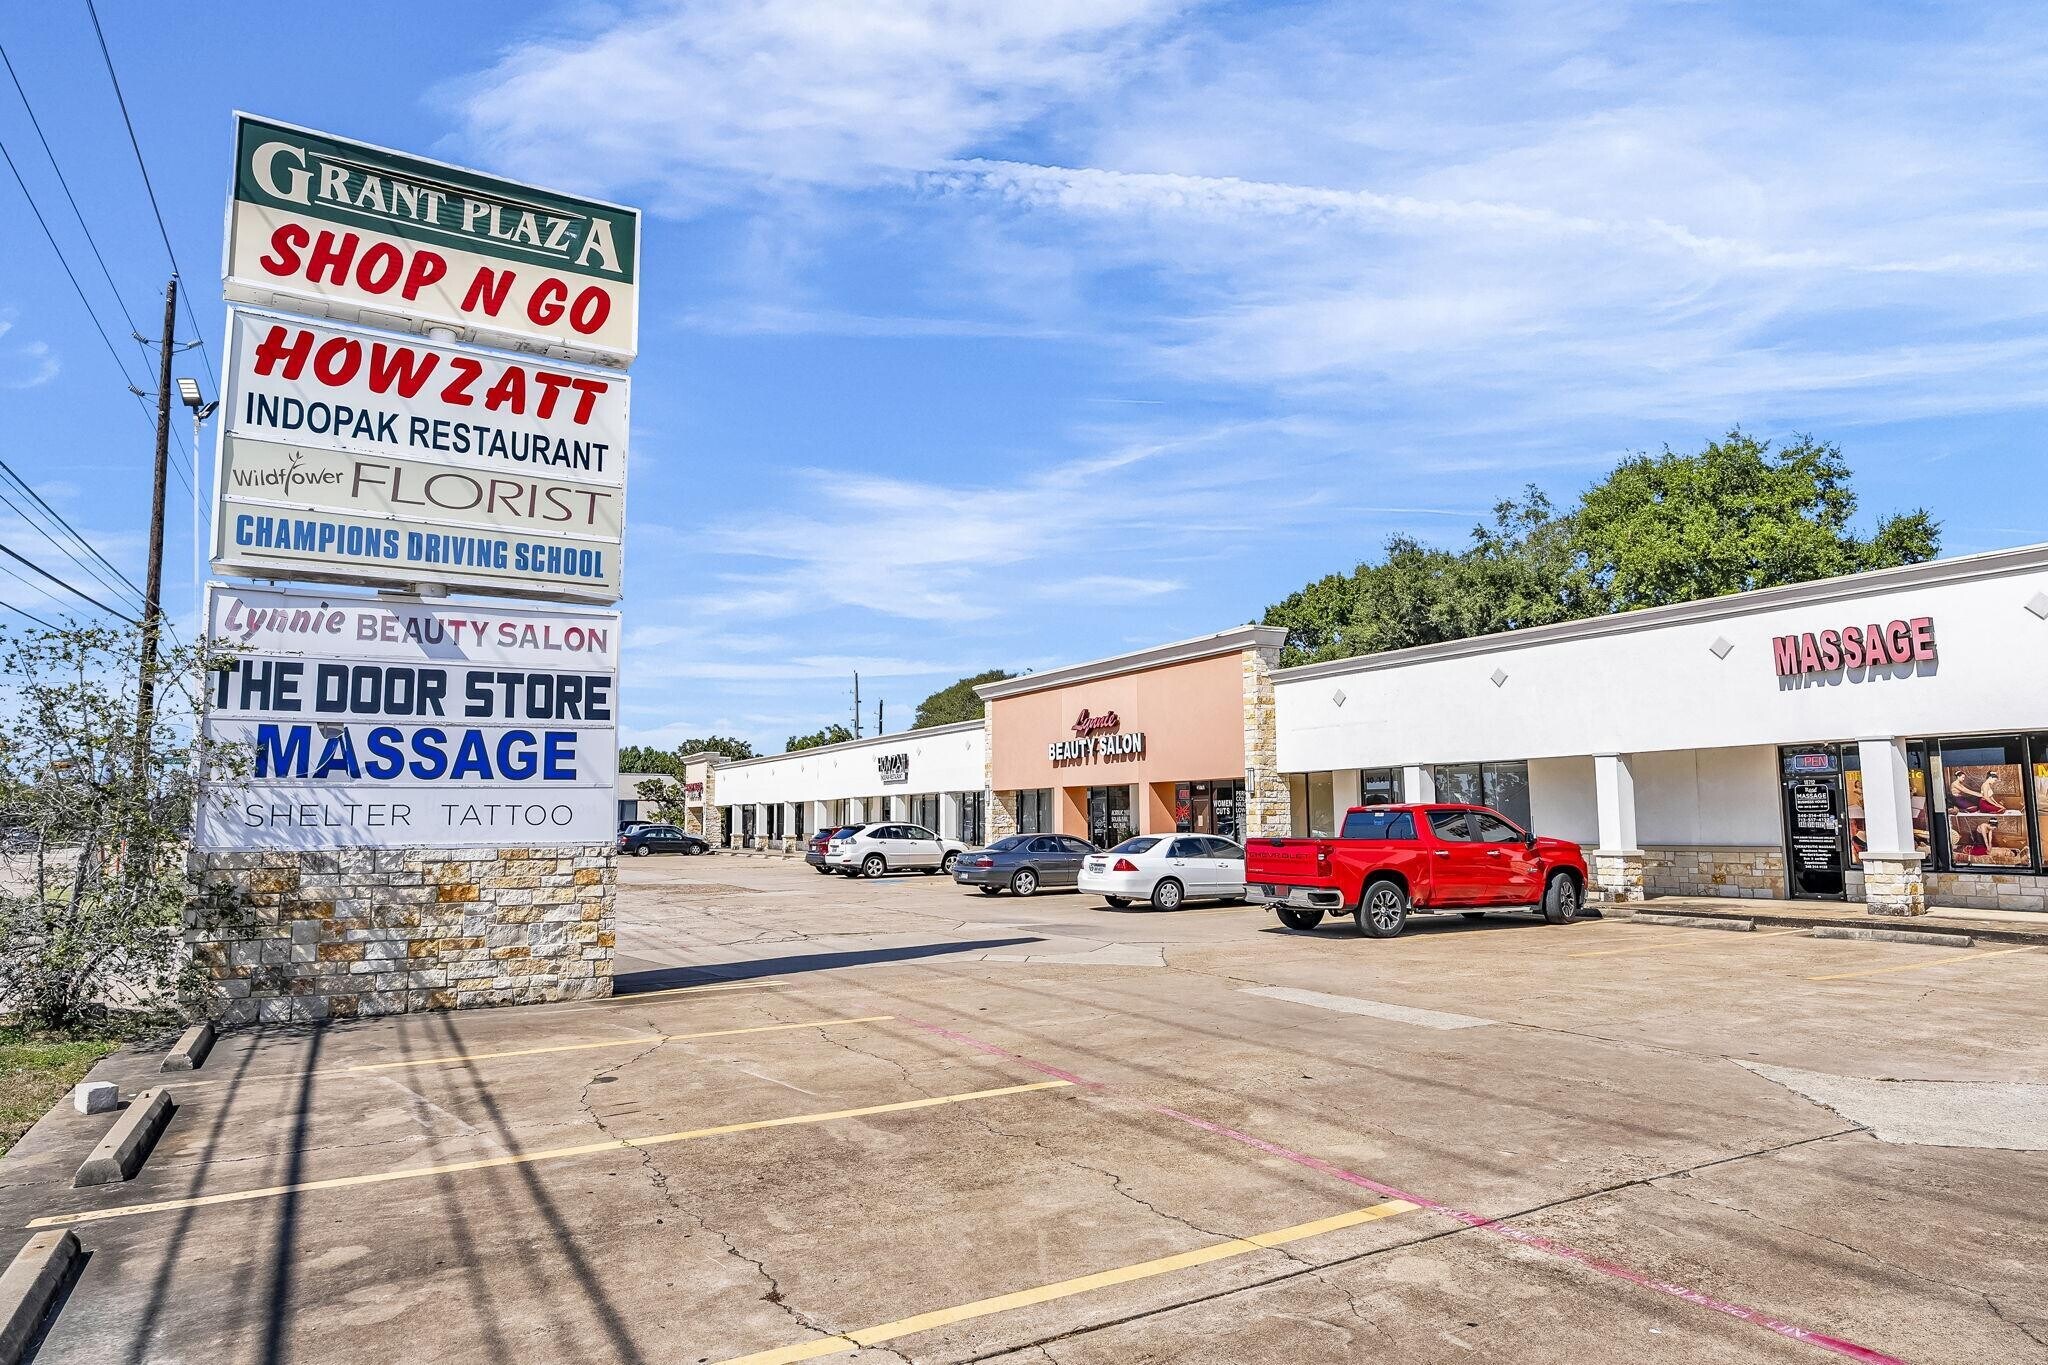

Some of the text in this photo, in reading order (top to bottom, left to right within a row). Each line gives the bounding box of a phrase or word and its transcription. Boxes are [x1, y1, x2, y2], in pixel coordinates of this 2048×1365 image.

[251, 141, 623, 273] GRANT PLAZA
[260, 223, 611, 335] SHOP N GO
[253, 325, 609, 426] HOWZATT
[246, 391, 609, 472] INDOPAK RESTAURANT
[351, 461, 612, 526] FLORIST
[236, 513, 604, 579] CHAMPIONS DRIVING SCHOOL
[224, 598, 608, 654] Lynnie BEAUTY SALON
[1772, 616, 1935, 677] MASSAGE
[211, 659, 612, 721] THE DOOR STORE
[253, 723, 578, 781] MASSAGE
[1048, 732, 1143, 761] BEAUTY SALON
[1071, 709, 1117, 737] Lynnie
[244, 803, 574, 828] SHELTER TATTOO
[1213, 799, 1233, 807] WOMEN
[1215, 807, 1231, 815] CUTS
[1797, 792, 1827, 800] MASSAGE
[1249, 852, 1311, 860] CHEVROLET
